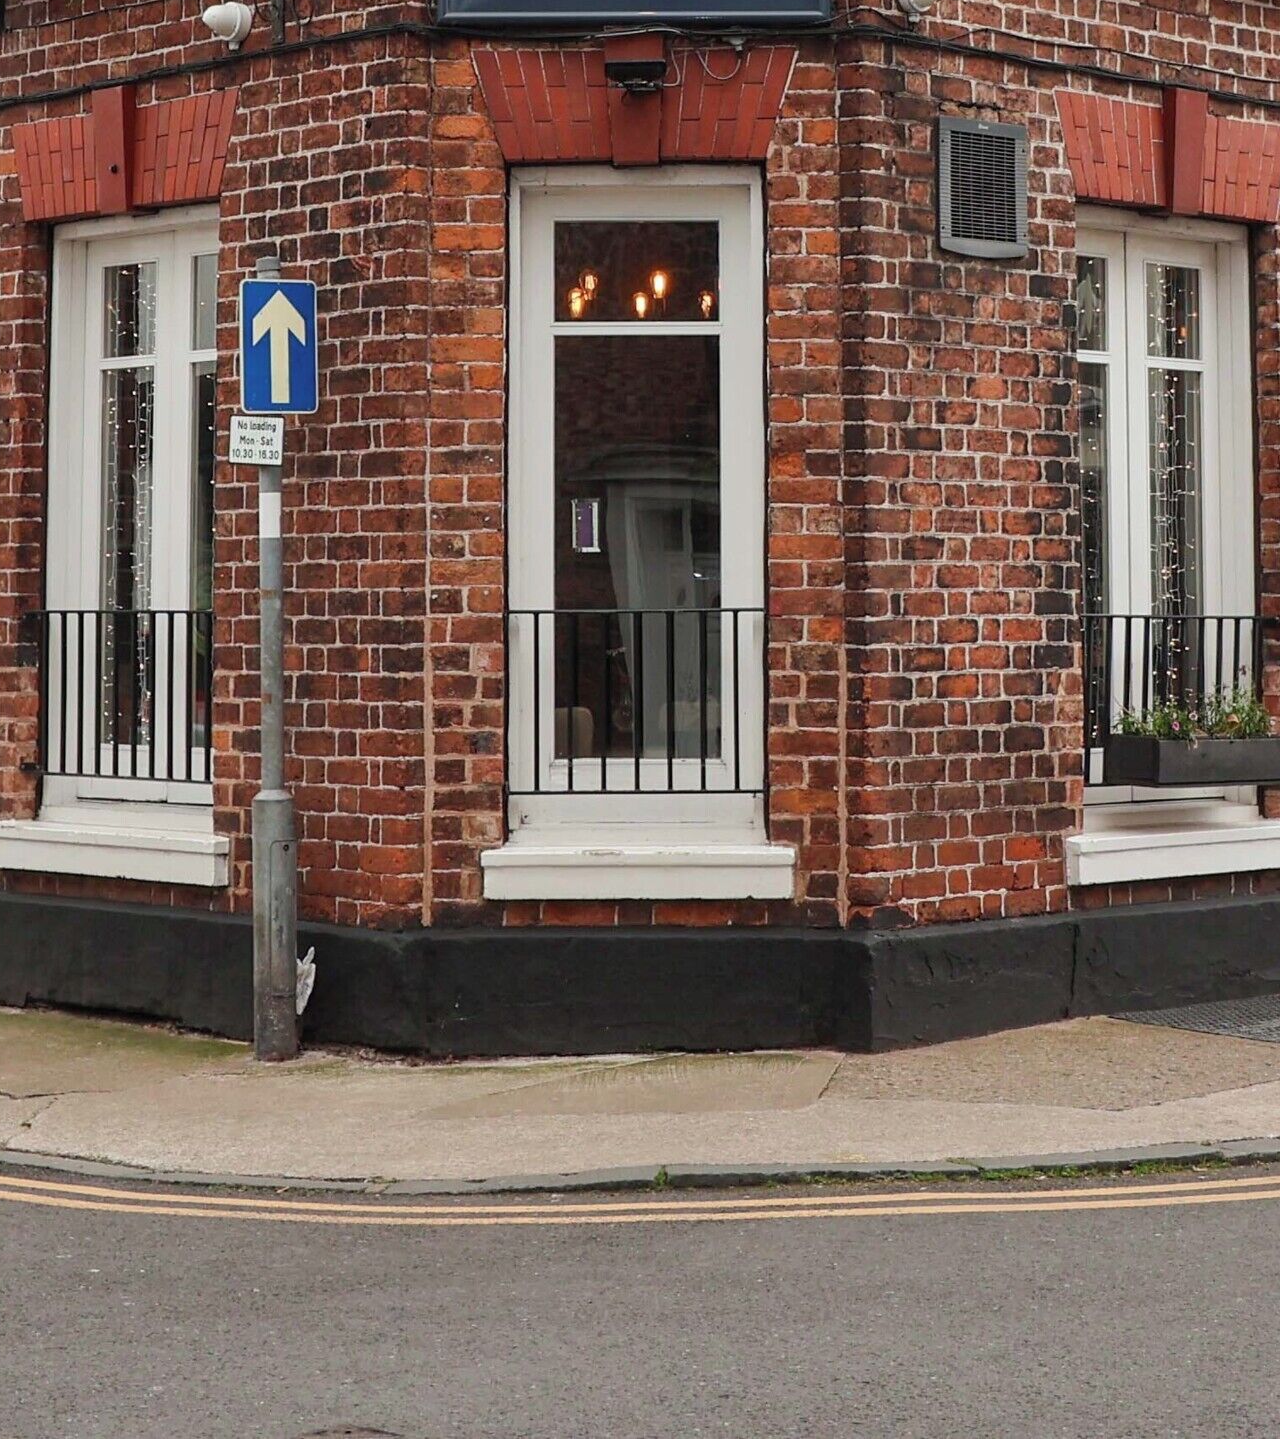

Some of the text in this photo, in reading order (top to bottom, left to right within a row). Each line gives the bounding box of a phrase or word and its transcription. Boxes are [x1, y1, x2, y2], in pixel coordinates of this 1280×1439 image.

[237, 420, 277, 433] No loading
[239, 435, 255, 445] Mon
[260, 436, 274, 446] Sat
[232, 448, 253, 459] 10.30
